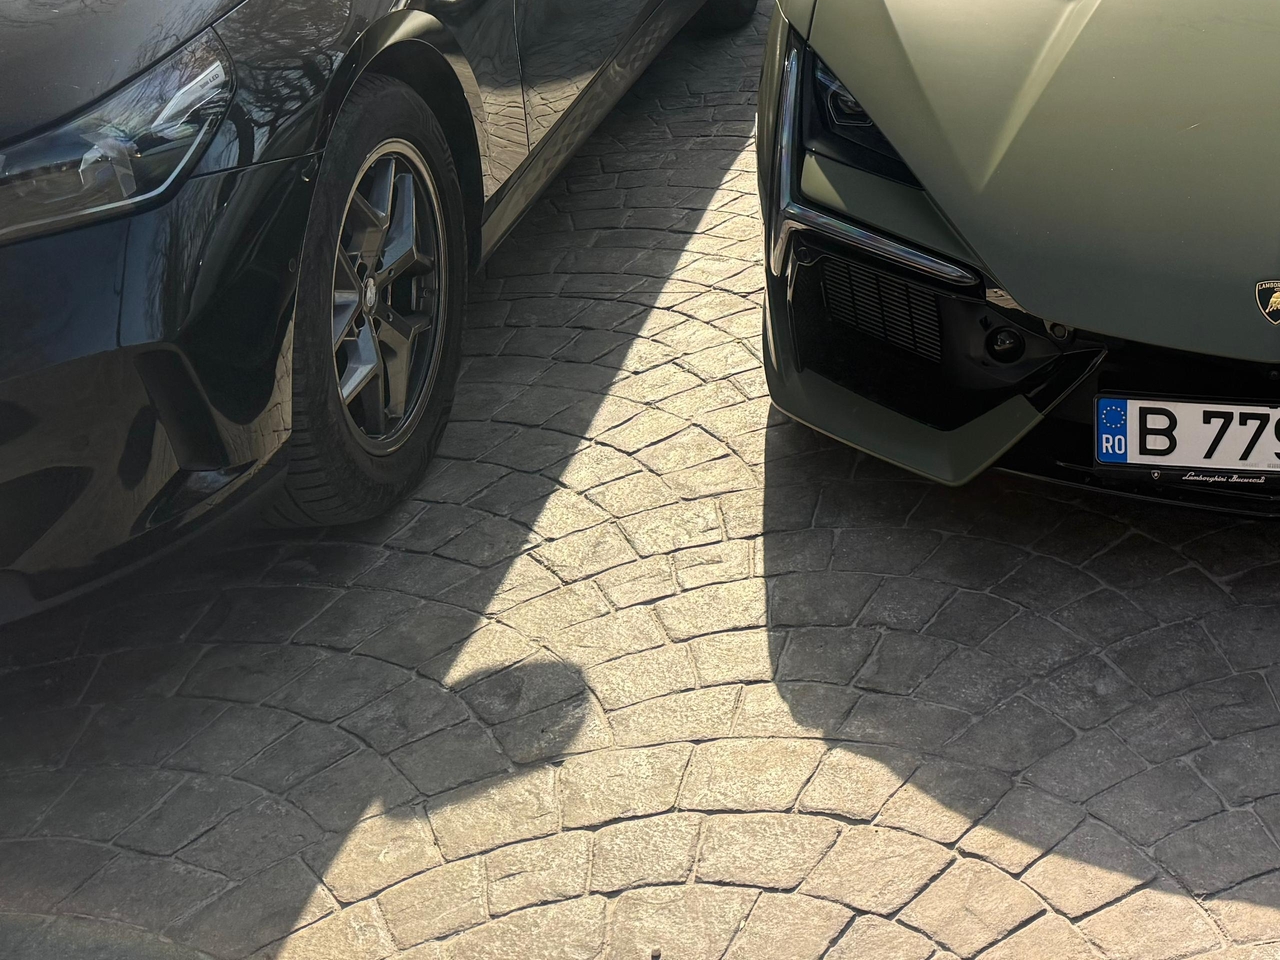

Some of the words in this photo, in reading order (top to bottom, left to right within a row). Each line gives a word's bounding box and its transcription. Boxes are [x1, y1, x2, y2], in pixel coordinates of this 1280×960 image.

[1102, 434, 1126, 455] RO
[1138, 406, 1178, 456] B
[1182, 471, 1228, 483] Lamborghini
